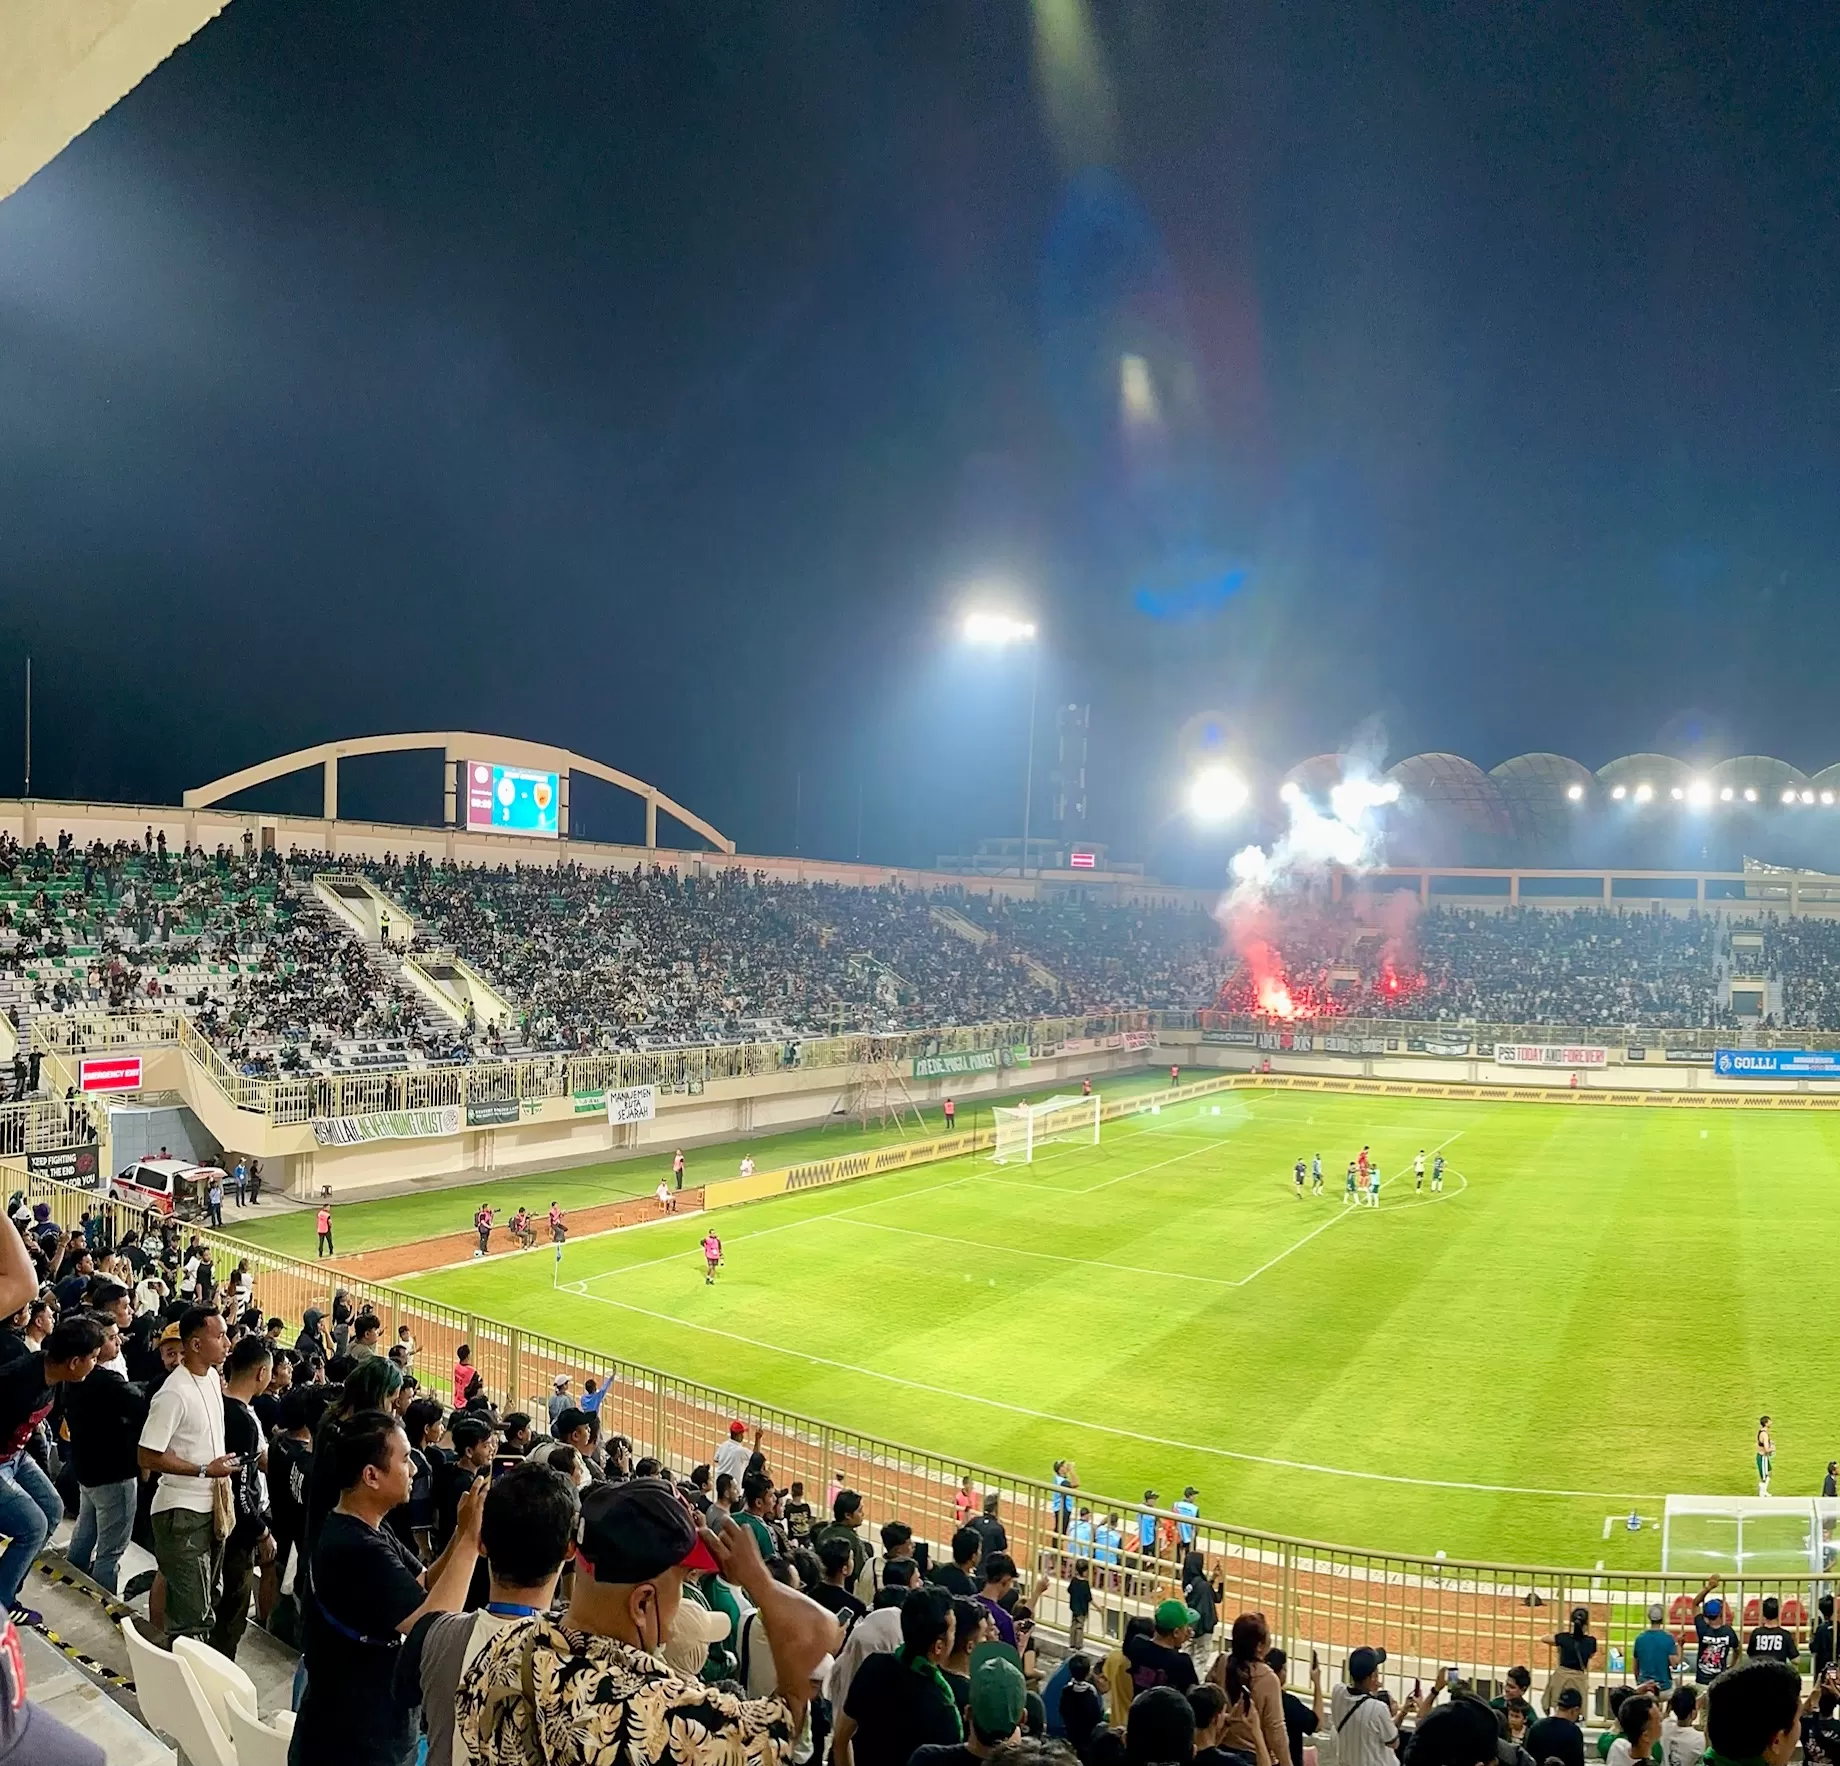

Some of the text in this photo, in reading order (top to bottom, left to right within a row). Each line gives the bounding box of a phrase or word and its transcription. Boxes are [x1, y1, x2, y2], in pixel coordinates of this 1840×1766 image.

[1499, 1047, 1516, 1060] PSS
[1516, 1047, 1543, 1061] TODAY
[610, 1088, 651, 1103] MANAJEMEN
[624, 1099, 641, 1109] BUTA
[617, 1106, 649, 1120] SEJARAH
[31, 1153, 77, 1166] KEEP FIGHTING
[50, 1167, 62, 1177] THE
[62, 1165, 75, 1177] END
[81, 1173, 95, 1185] YOU
[1755, 1634, 1783, 1651] 1976
